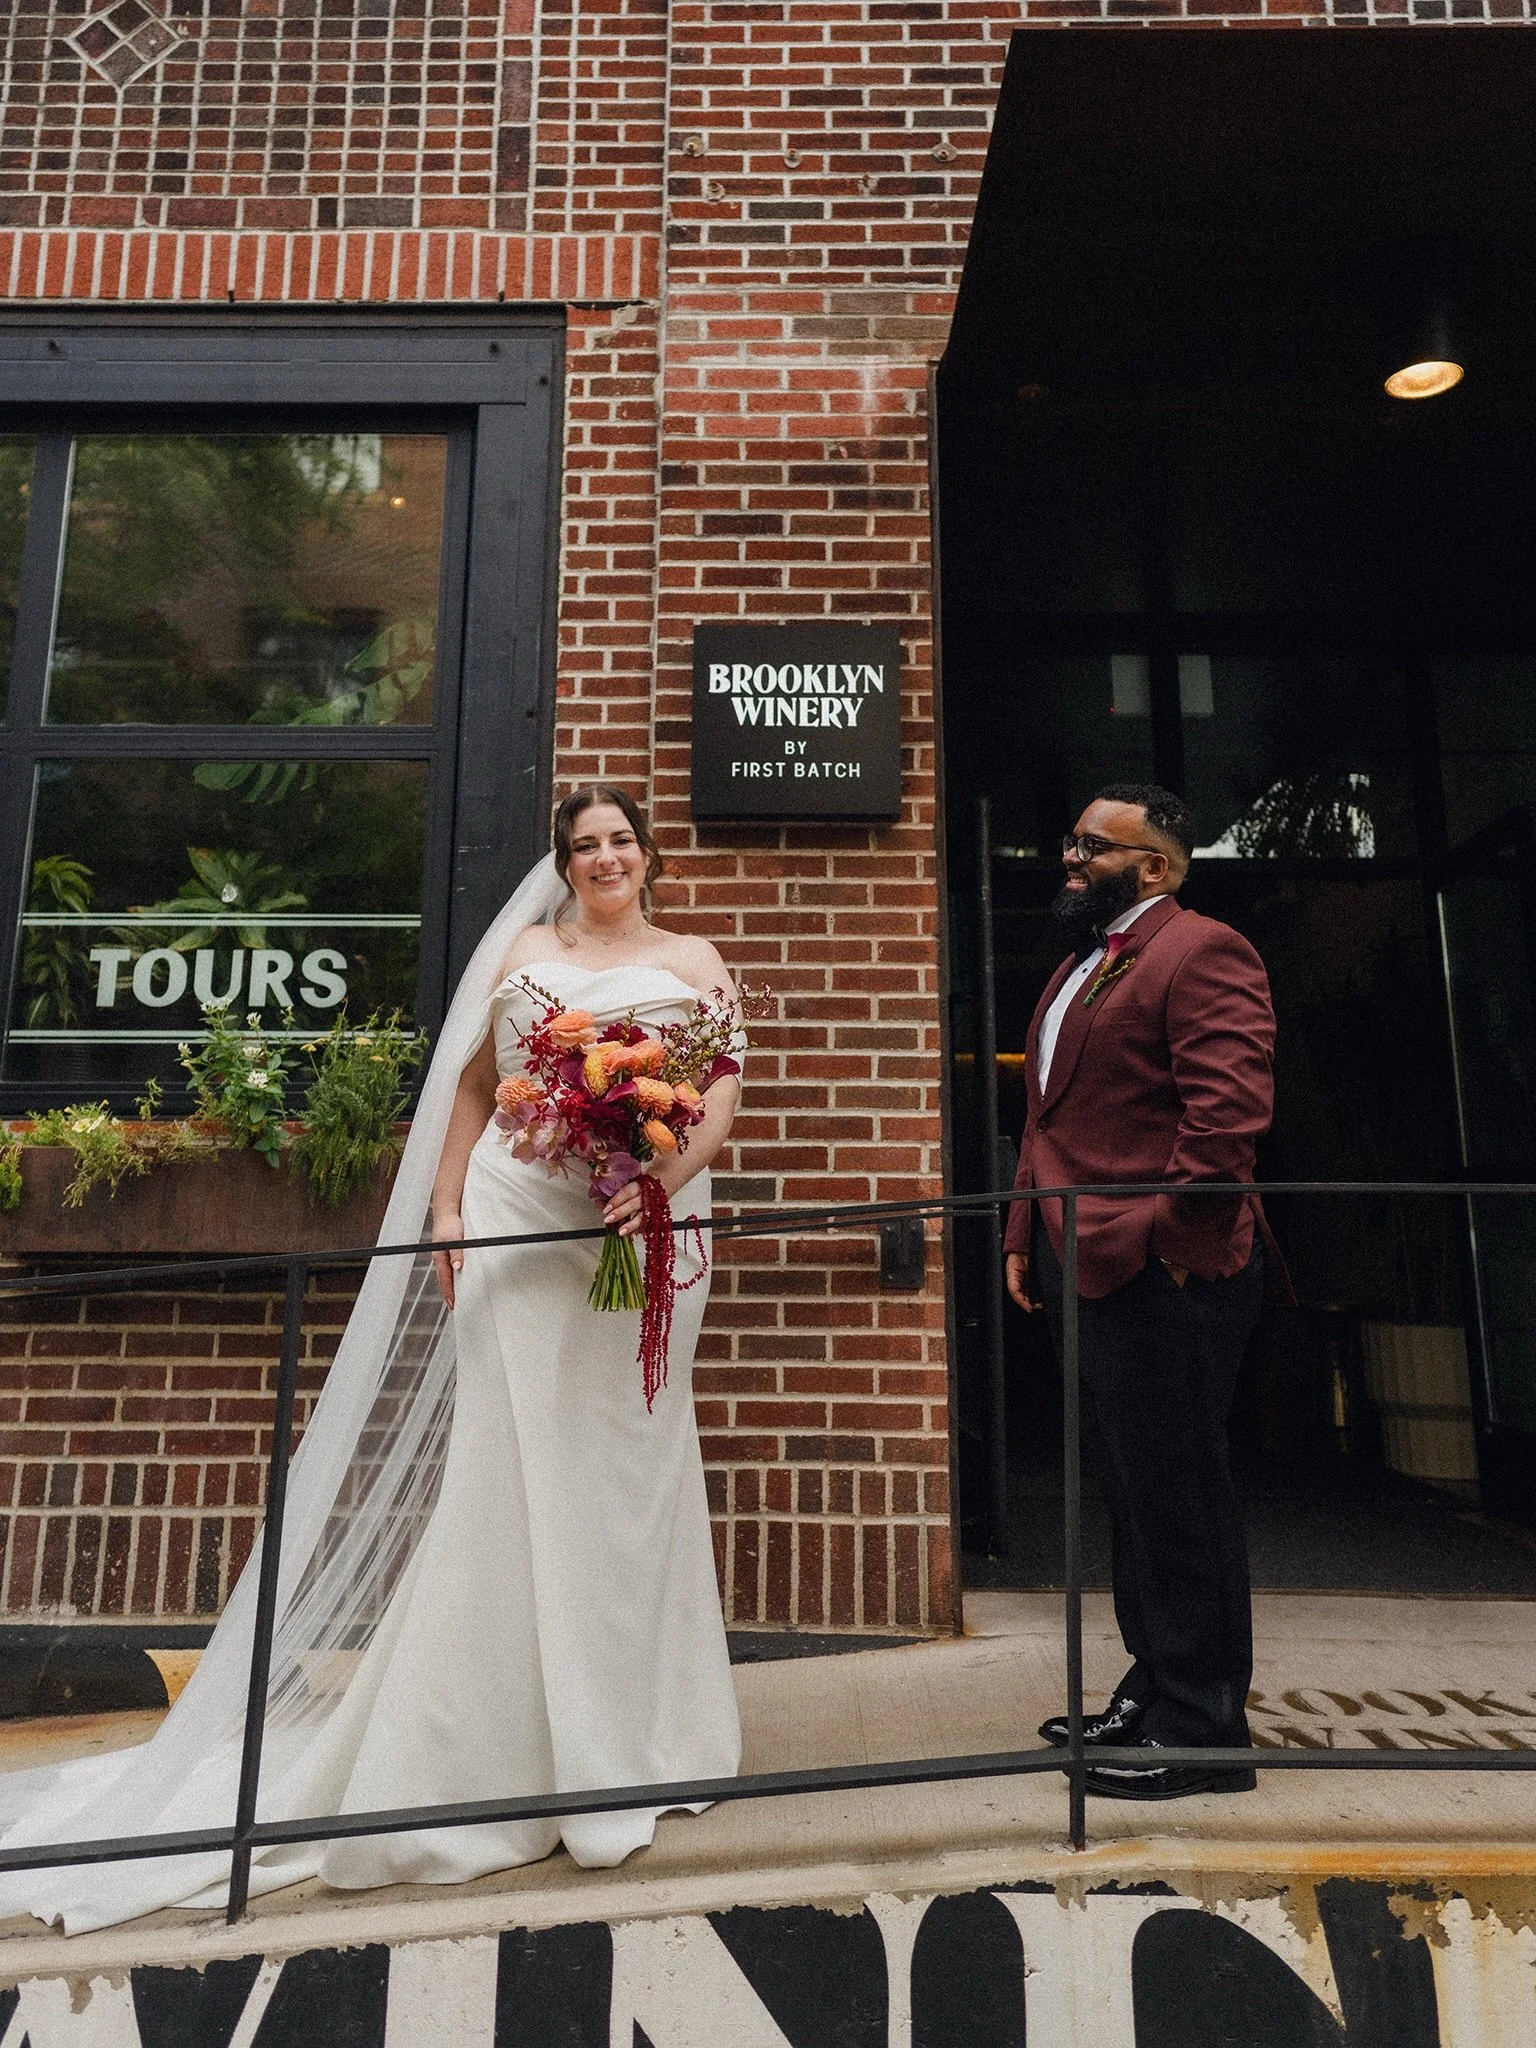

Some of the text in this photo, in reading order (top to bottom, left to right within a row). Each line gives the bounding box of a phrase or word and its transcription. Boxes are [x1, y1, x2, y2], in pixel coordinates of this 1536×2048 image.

[708, 663, 884, 695] BROOKLYN
[730, 696, 864, 729] WINERY
[784, 741, 807, 755] BY
[731, 762, 861, 778] FIRST BATCH
[89, 948, 348, 1009] TOURS
